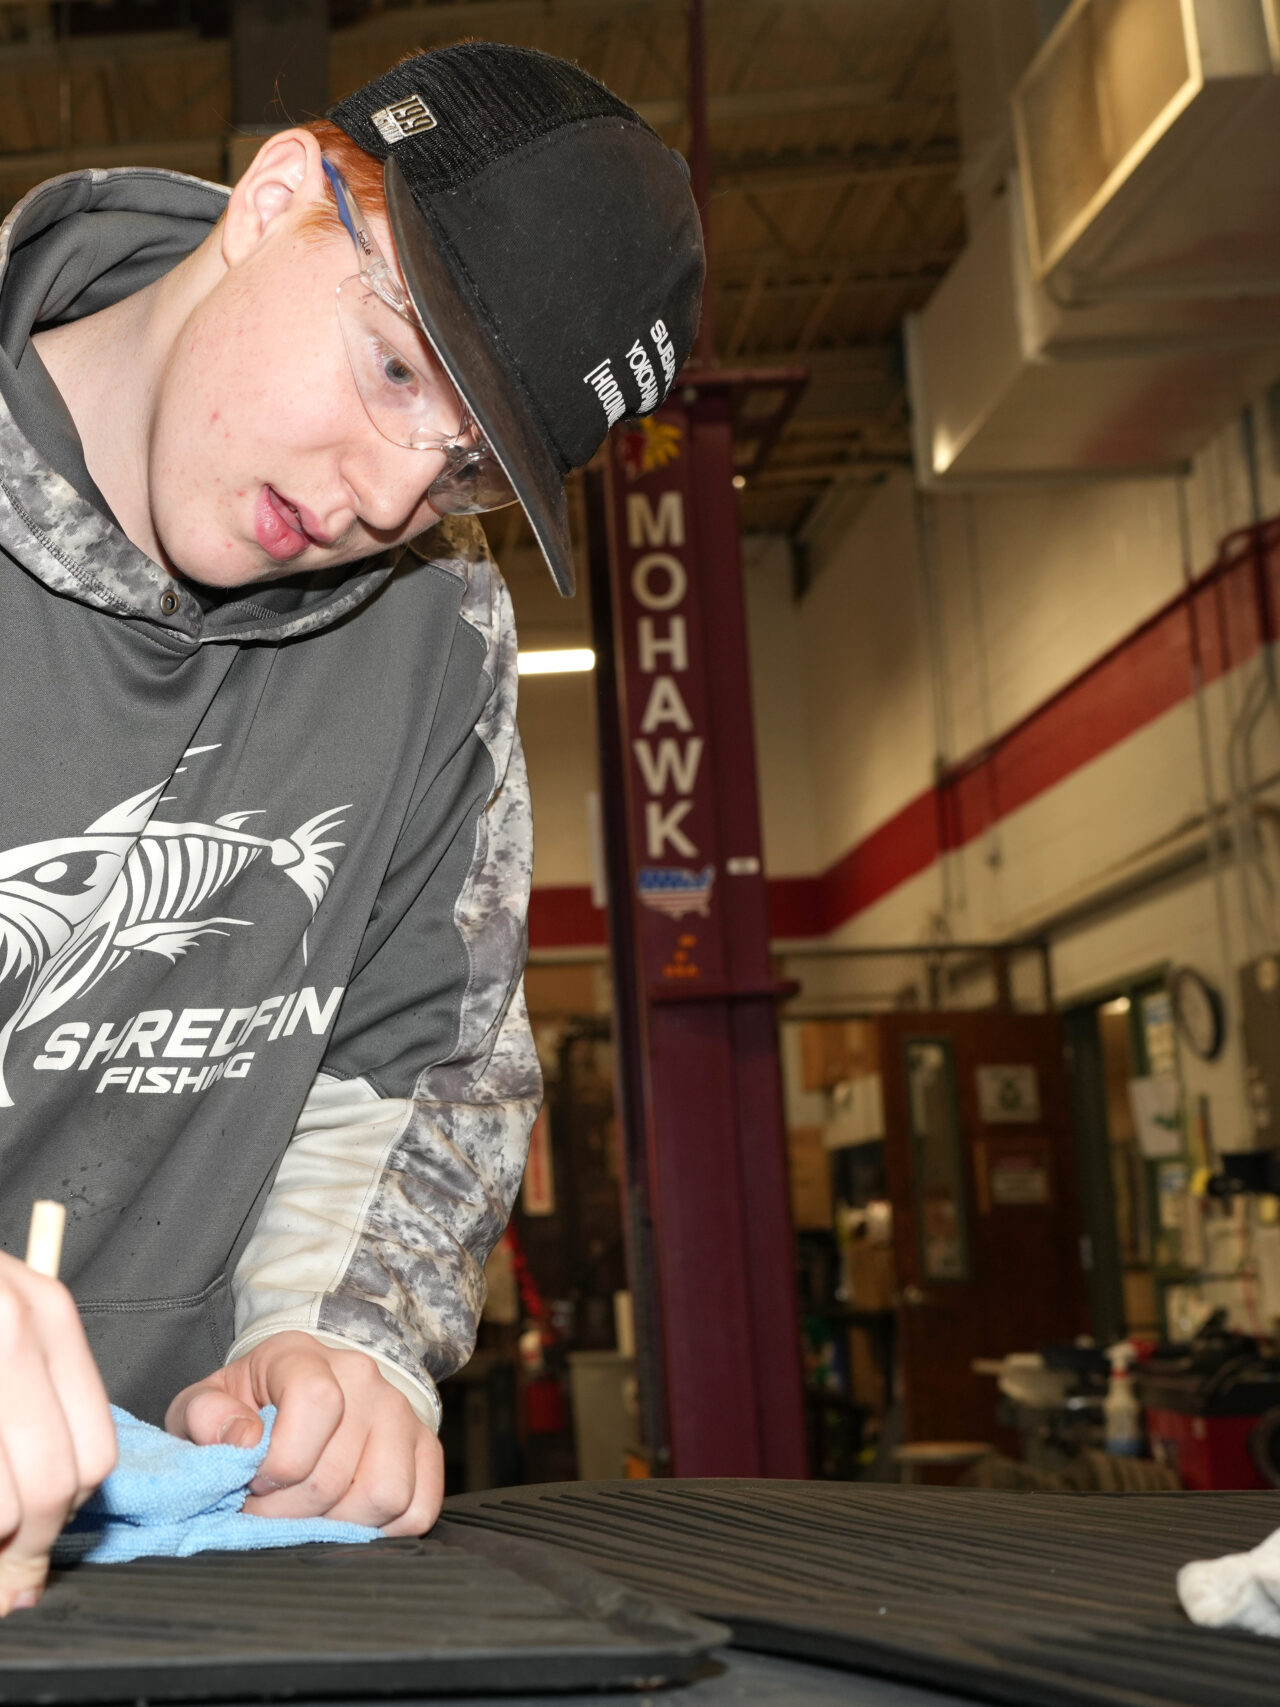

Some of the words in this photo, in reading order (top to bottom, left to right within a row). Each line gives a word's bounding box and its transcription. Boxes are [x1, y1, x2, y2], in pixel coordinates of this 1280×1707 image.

[625, 338, 659, 413] YOKOHAM
[650, 319, 676, 404] SUBAR
[626, 491, 703, 859] MOHAWK
[33, 986, 345, 1071] SHREDFIN
[95, 1052, 256, 1094] FISHING
